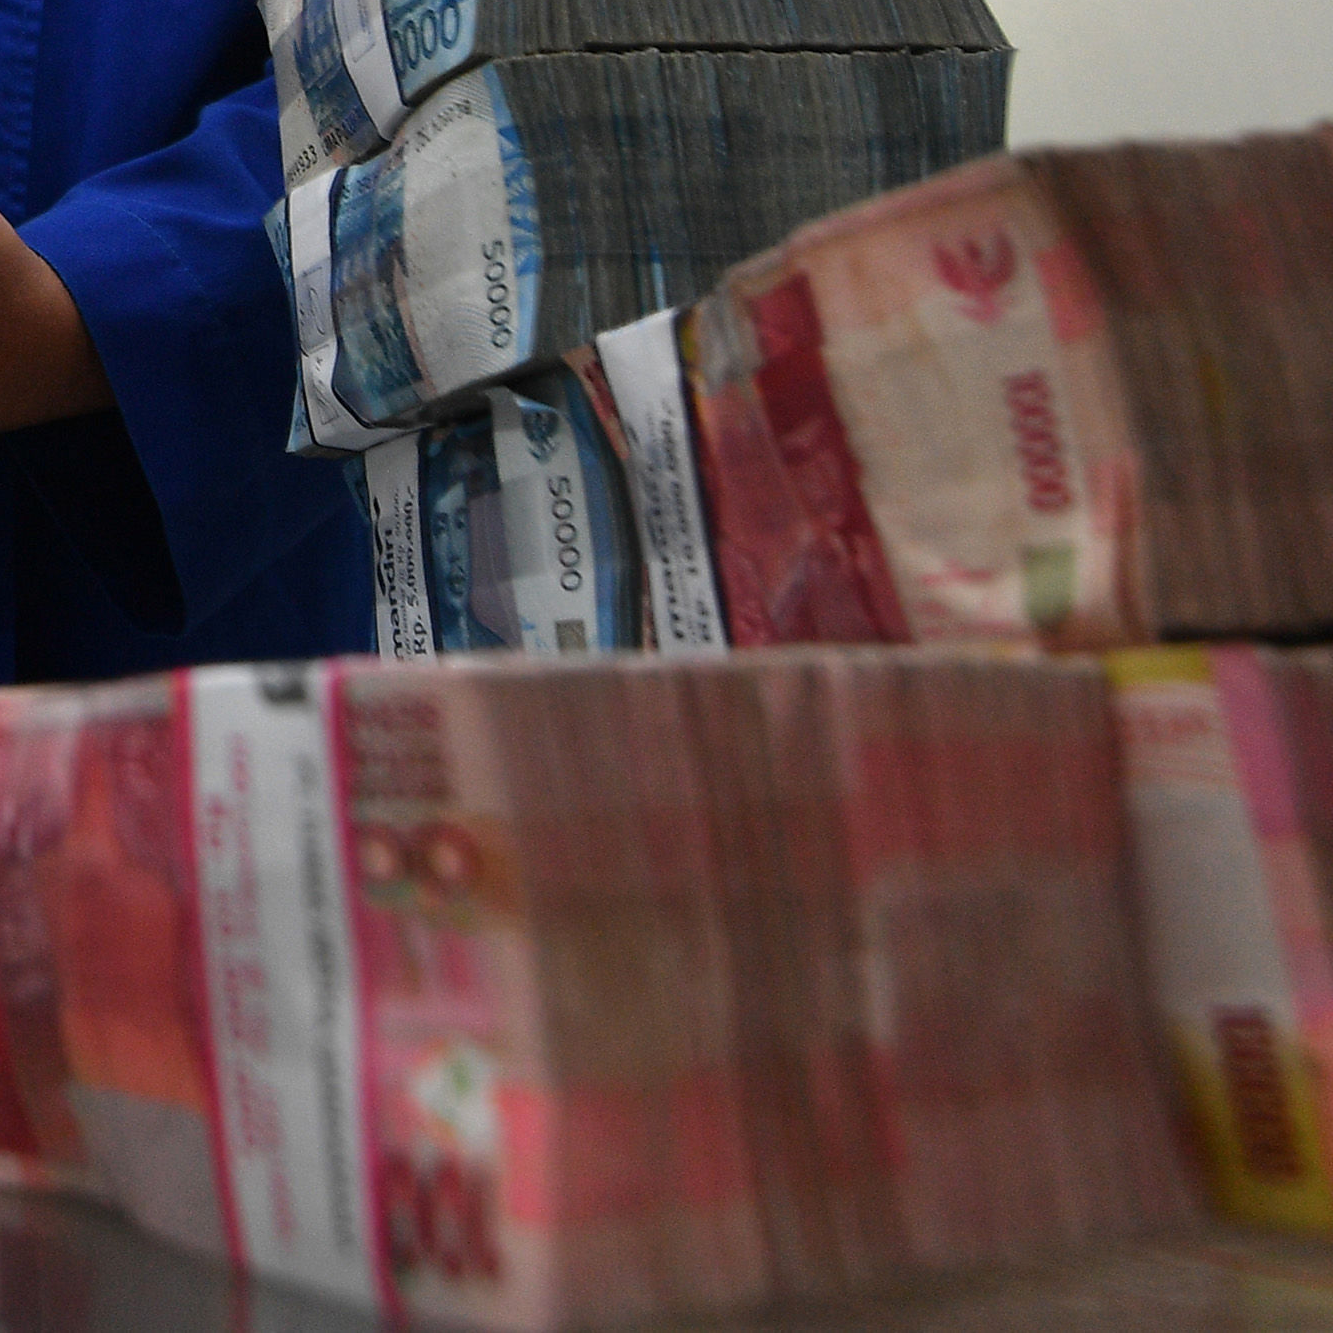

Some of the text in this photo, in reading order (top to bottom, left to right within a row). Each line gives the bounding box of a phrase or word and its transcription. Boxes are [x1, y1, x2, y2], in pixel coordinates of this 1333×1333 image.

[391, 0, 459, 79] 0000
[482, 239, 515, 349] 50000
[548, 475, 582, 591] 50000
[384, 528, 405, 662] mandiri
[413, 614, 429, 656] Rp.
